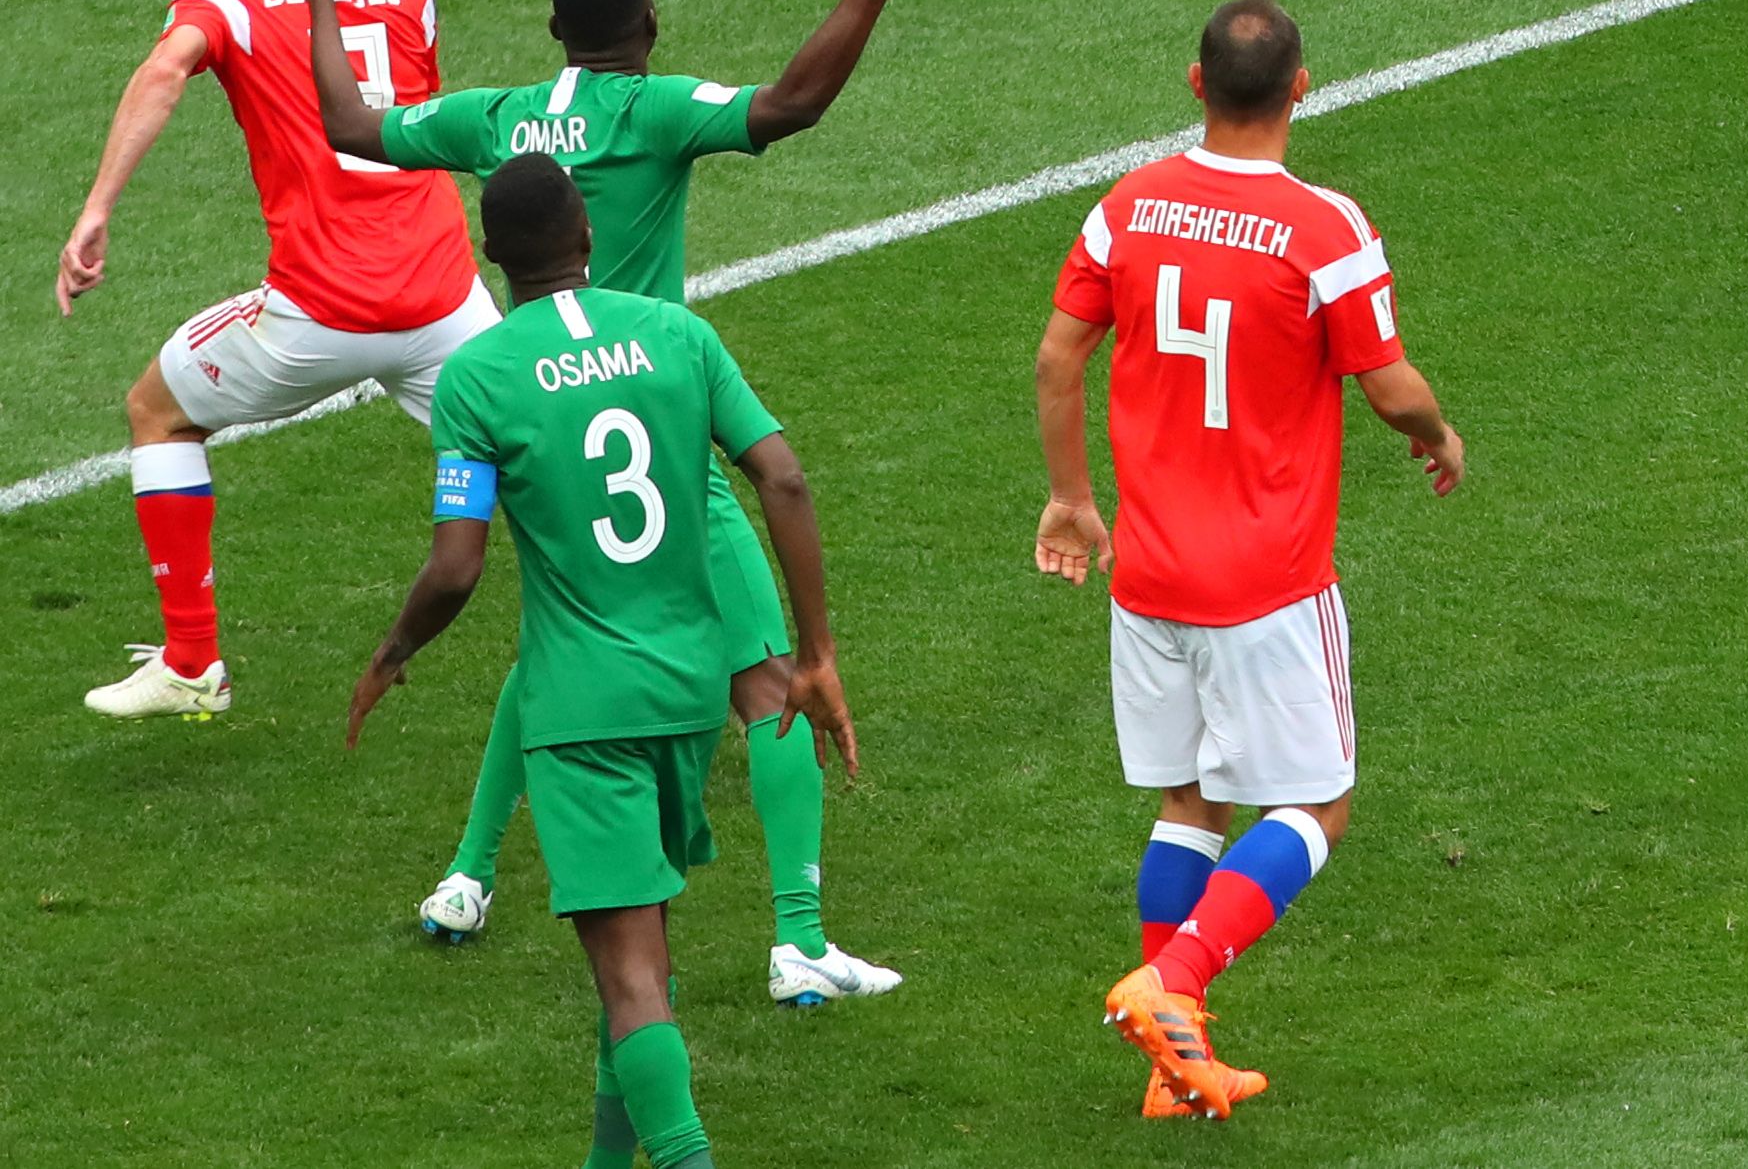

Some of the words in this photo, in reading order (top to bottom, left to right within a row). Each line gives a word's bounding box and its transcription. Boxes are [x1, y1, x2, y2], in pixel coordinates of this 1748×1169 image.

[510, 116, 588, 155] OMAR
[1127, 198, 1293, 258] IGNASHEVICH
[535, 339, 655, 392] OSAMA
[1155, 264, 1233, 430] 4
[442, 494, 467, 506] FIFA
[584, 407, 666, 564] 3
